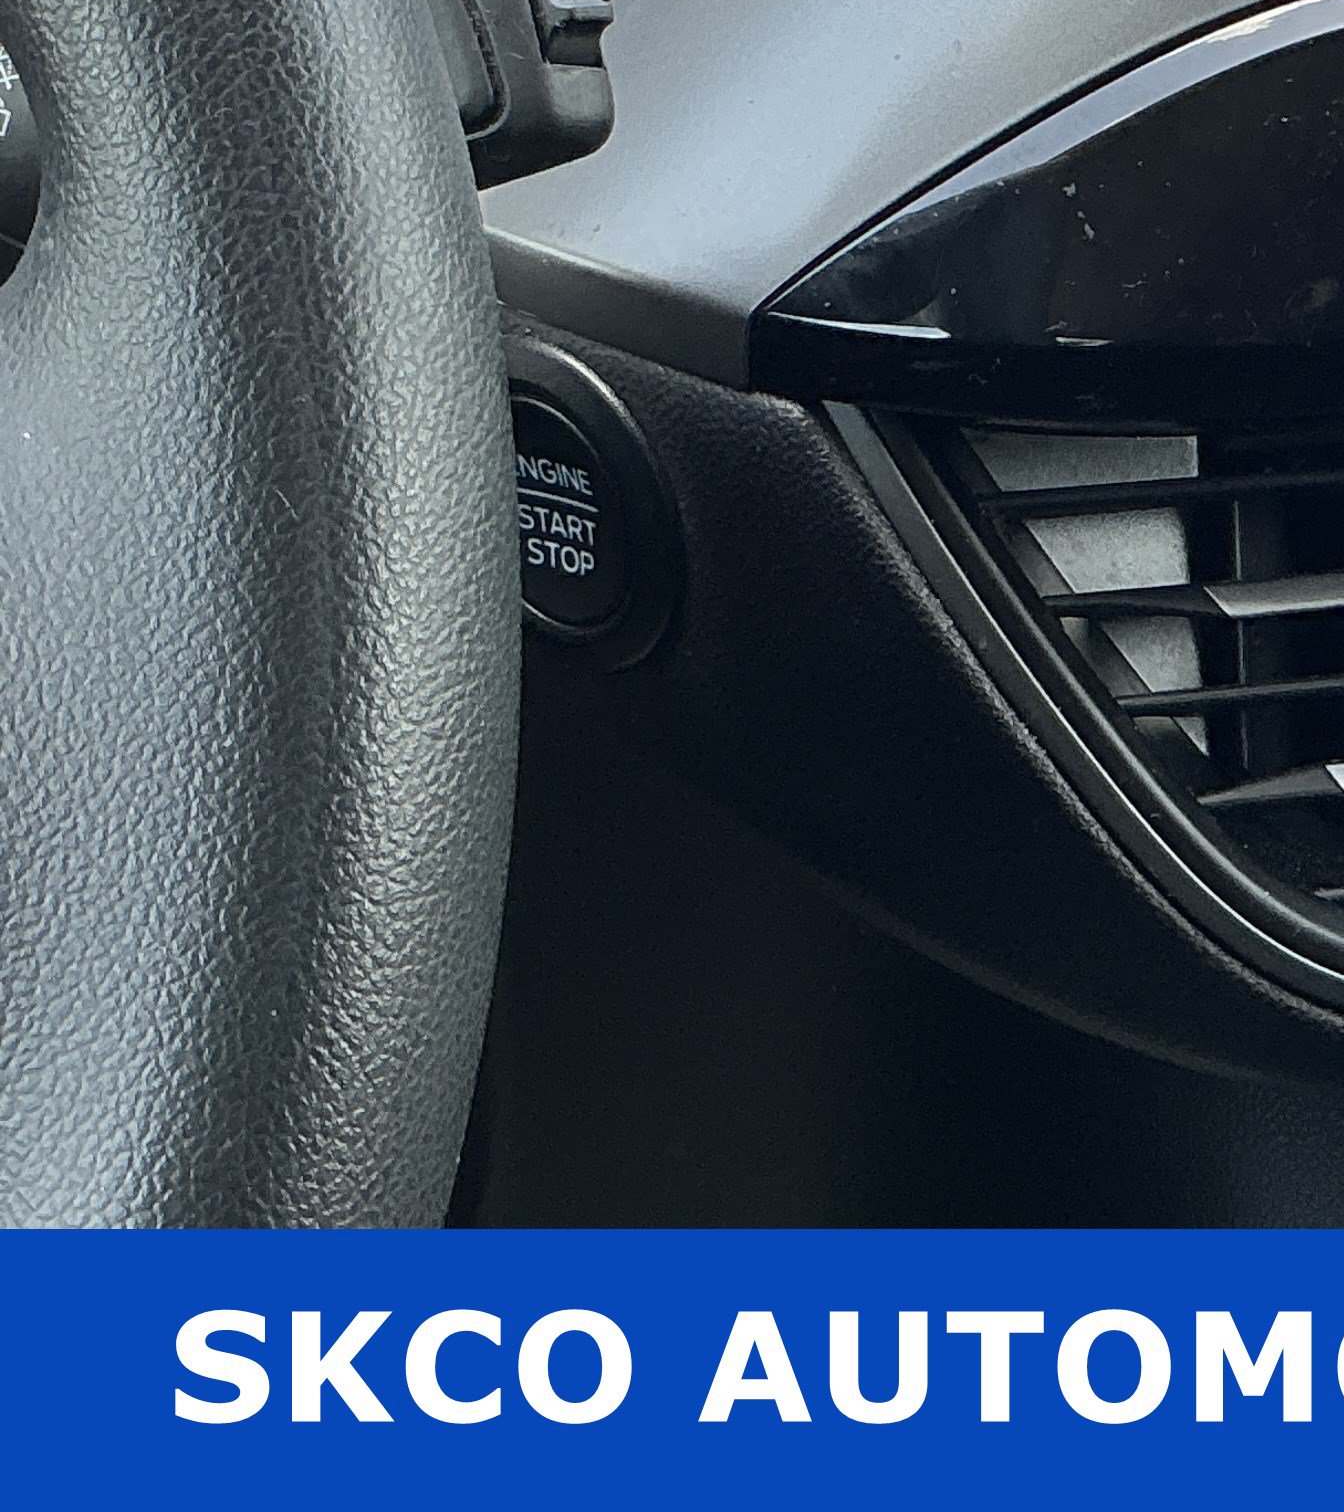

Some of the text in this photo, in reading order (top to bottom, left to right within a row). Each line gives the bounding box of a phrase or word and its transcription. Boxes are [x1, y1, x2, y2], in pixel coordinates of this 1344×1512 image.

[516, 454, 593, 496] NGINE
[518, 504, 597, 546] START
[526, 538, 595, 576] STOP
